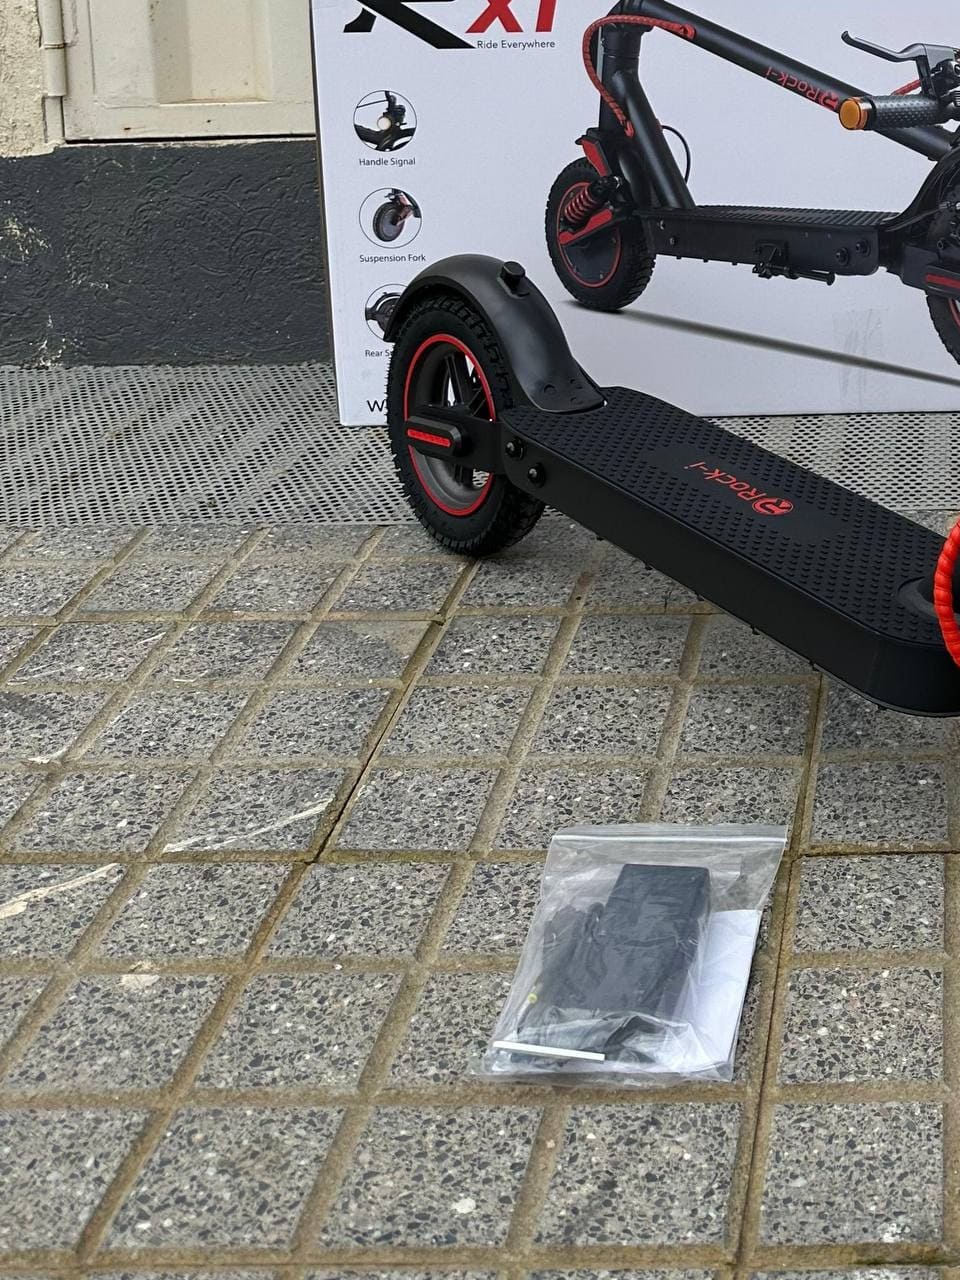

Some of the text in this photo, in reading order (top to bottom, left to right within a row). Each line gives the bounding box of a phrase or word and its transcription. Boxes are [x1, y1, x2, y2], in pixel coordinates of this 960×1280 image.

[477, 40, 556, 51] Ride Everywhere
[359, 157, 416, 168] Handle Signal
[360, 253, 426, 264] Suspension Fork
[364, 349, 383, 358] Rear
[683, 461, 767, 501] Rock-i
